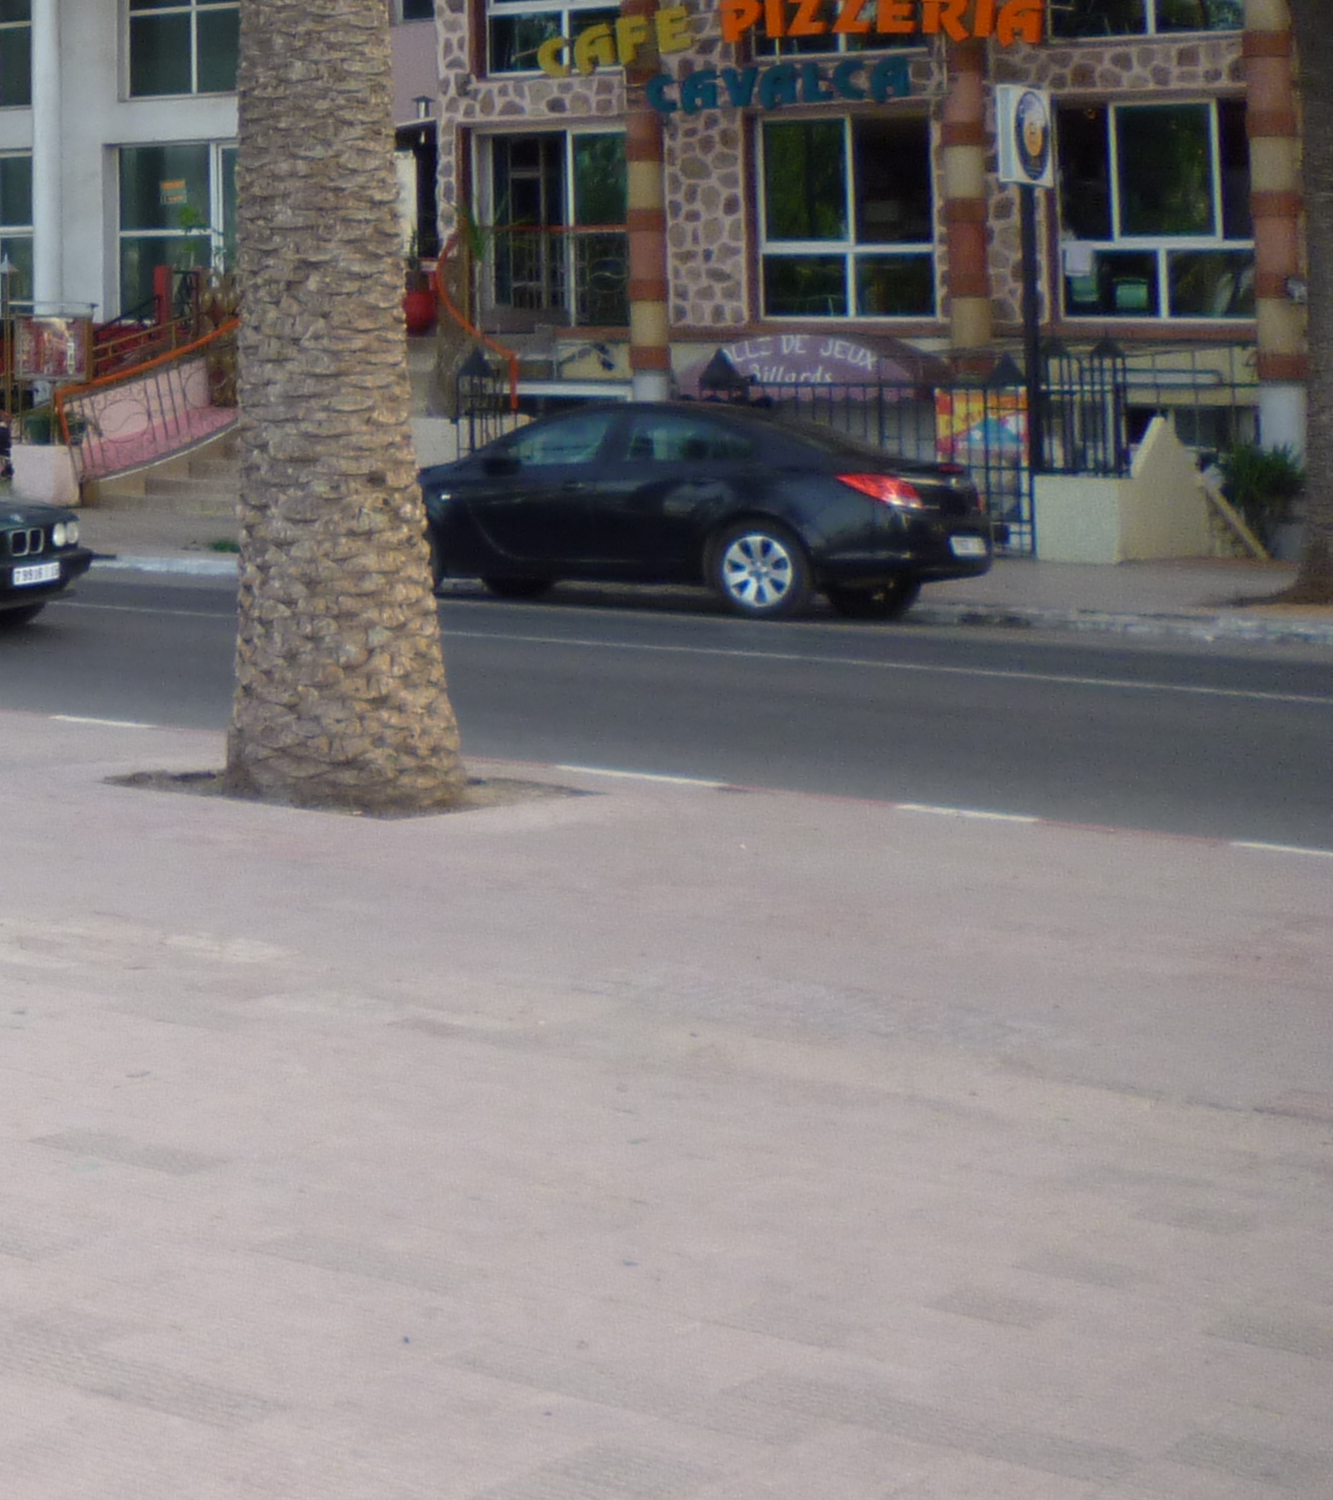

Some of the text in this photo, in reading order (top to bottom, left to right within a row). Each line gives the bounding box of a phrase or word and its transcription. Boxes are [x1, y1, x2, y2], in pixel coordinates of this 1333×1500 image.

[537, 5, 694, 77] CAFE
[645, 55, 910, 114] CAVALCA
[782, 335, 807, 354] DE
[820, 337, 878, 370] JEUX
